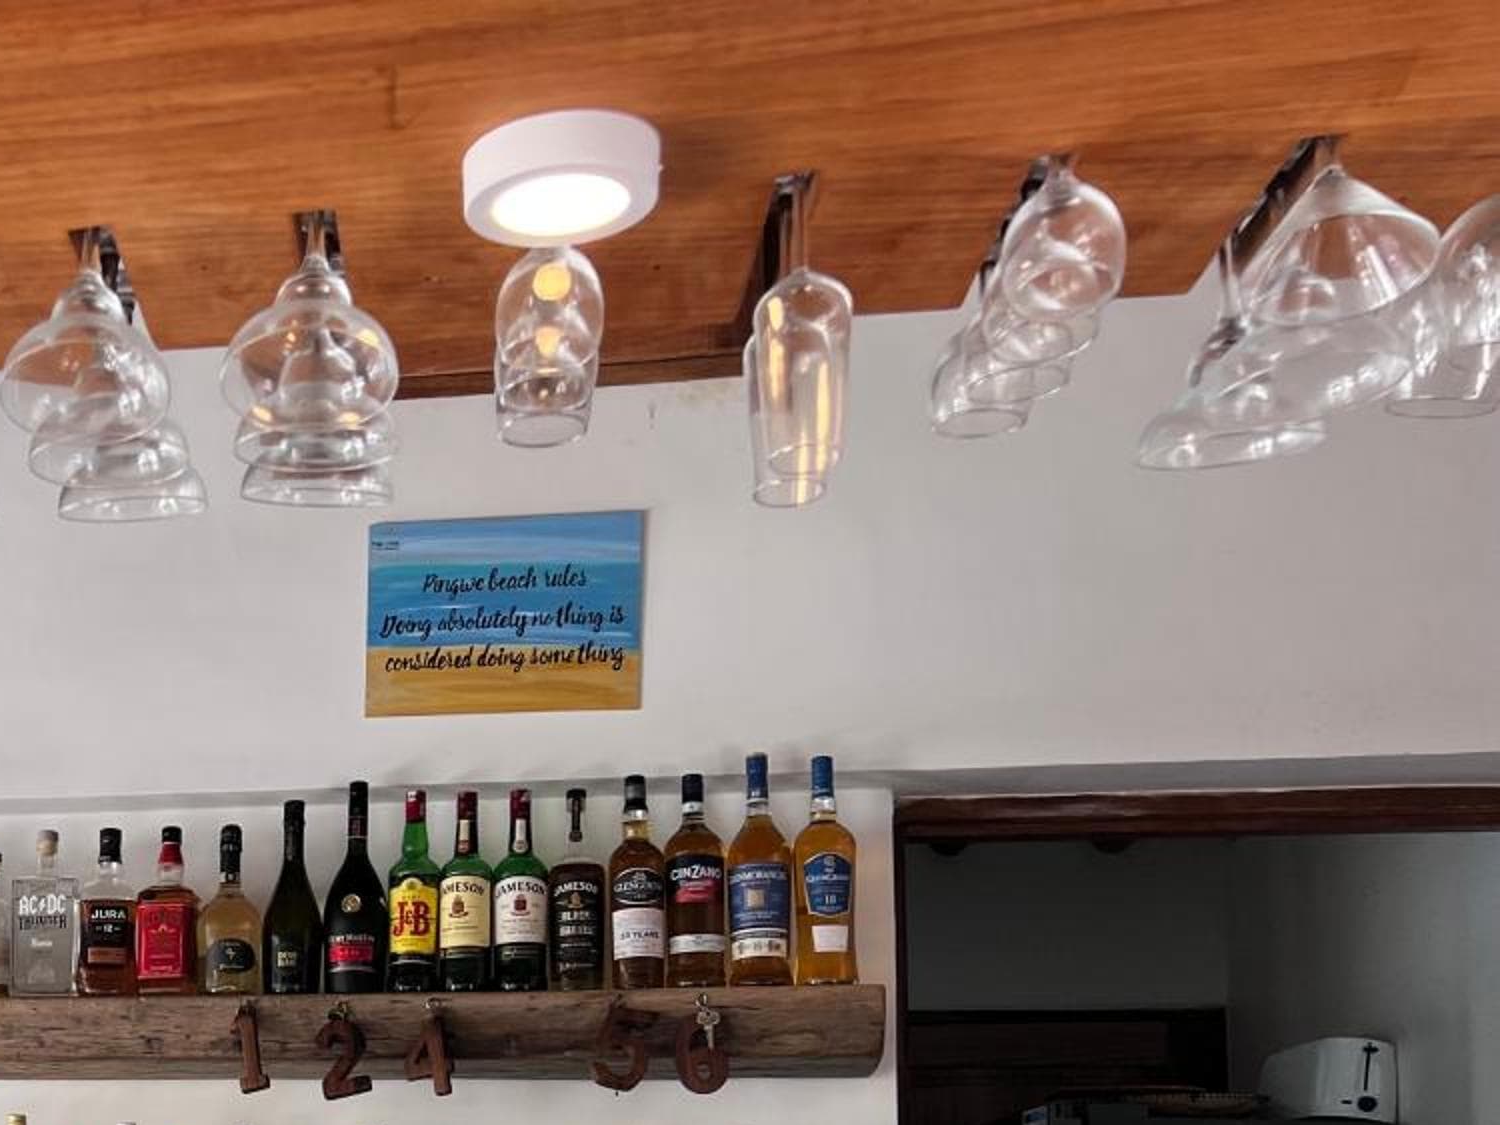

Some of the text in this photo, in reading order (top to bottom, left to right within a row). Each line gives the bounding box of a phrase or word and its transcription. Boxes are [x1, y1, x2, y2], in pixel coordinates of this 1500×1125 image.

[422, 563, 587, 601] Pingwe beach rules
[379, 613, 432, 641] Doing
[437, 605, 527, 637] absolutely
[609, 605, 625, 624] is
[385, 644, 472, 673] considered
[476, 642, 525, 673] doing
[442, 881, 486, 897] AMESON
[670, 863, 723, 881] CINZANO
[91, 908, 126, 919] JURA
[231, 1006, 270, 1095] 1
[316, 1019, 373, 1100] 2
[405, 1014, 454, 1096] 4
[592, 1006, 660, 1093] 5
[675, 1010, 729, 1095] 6
